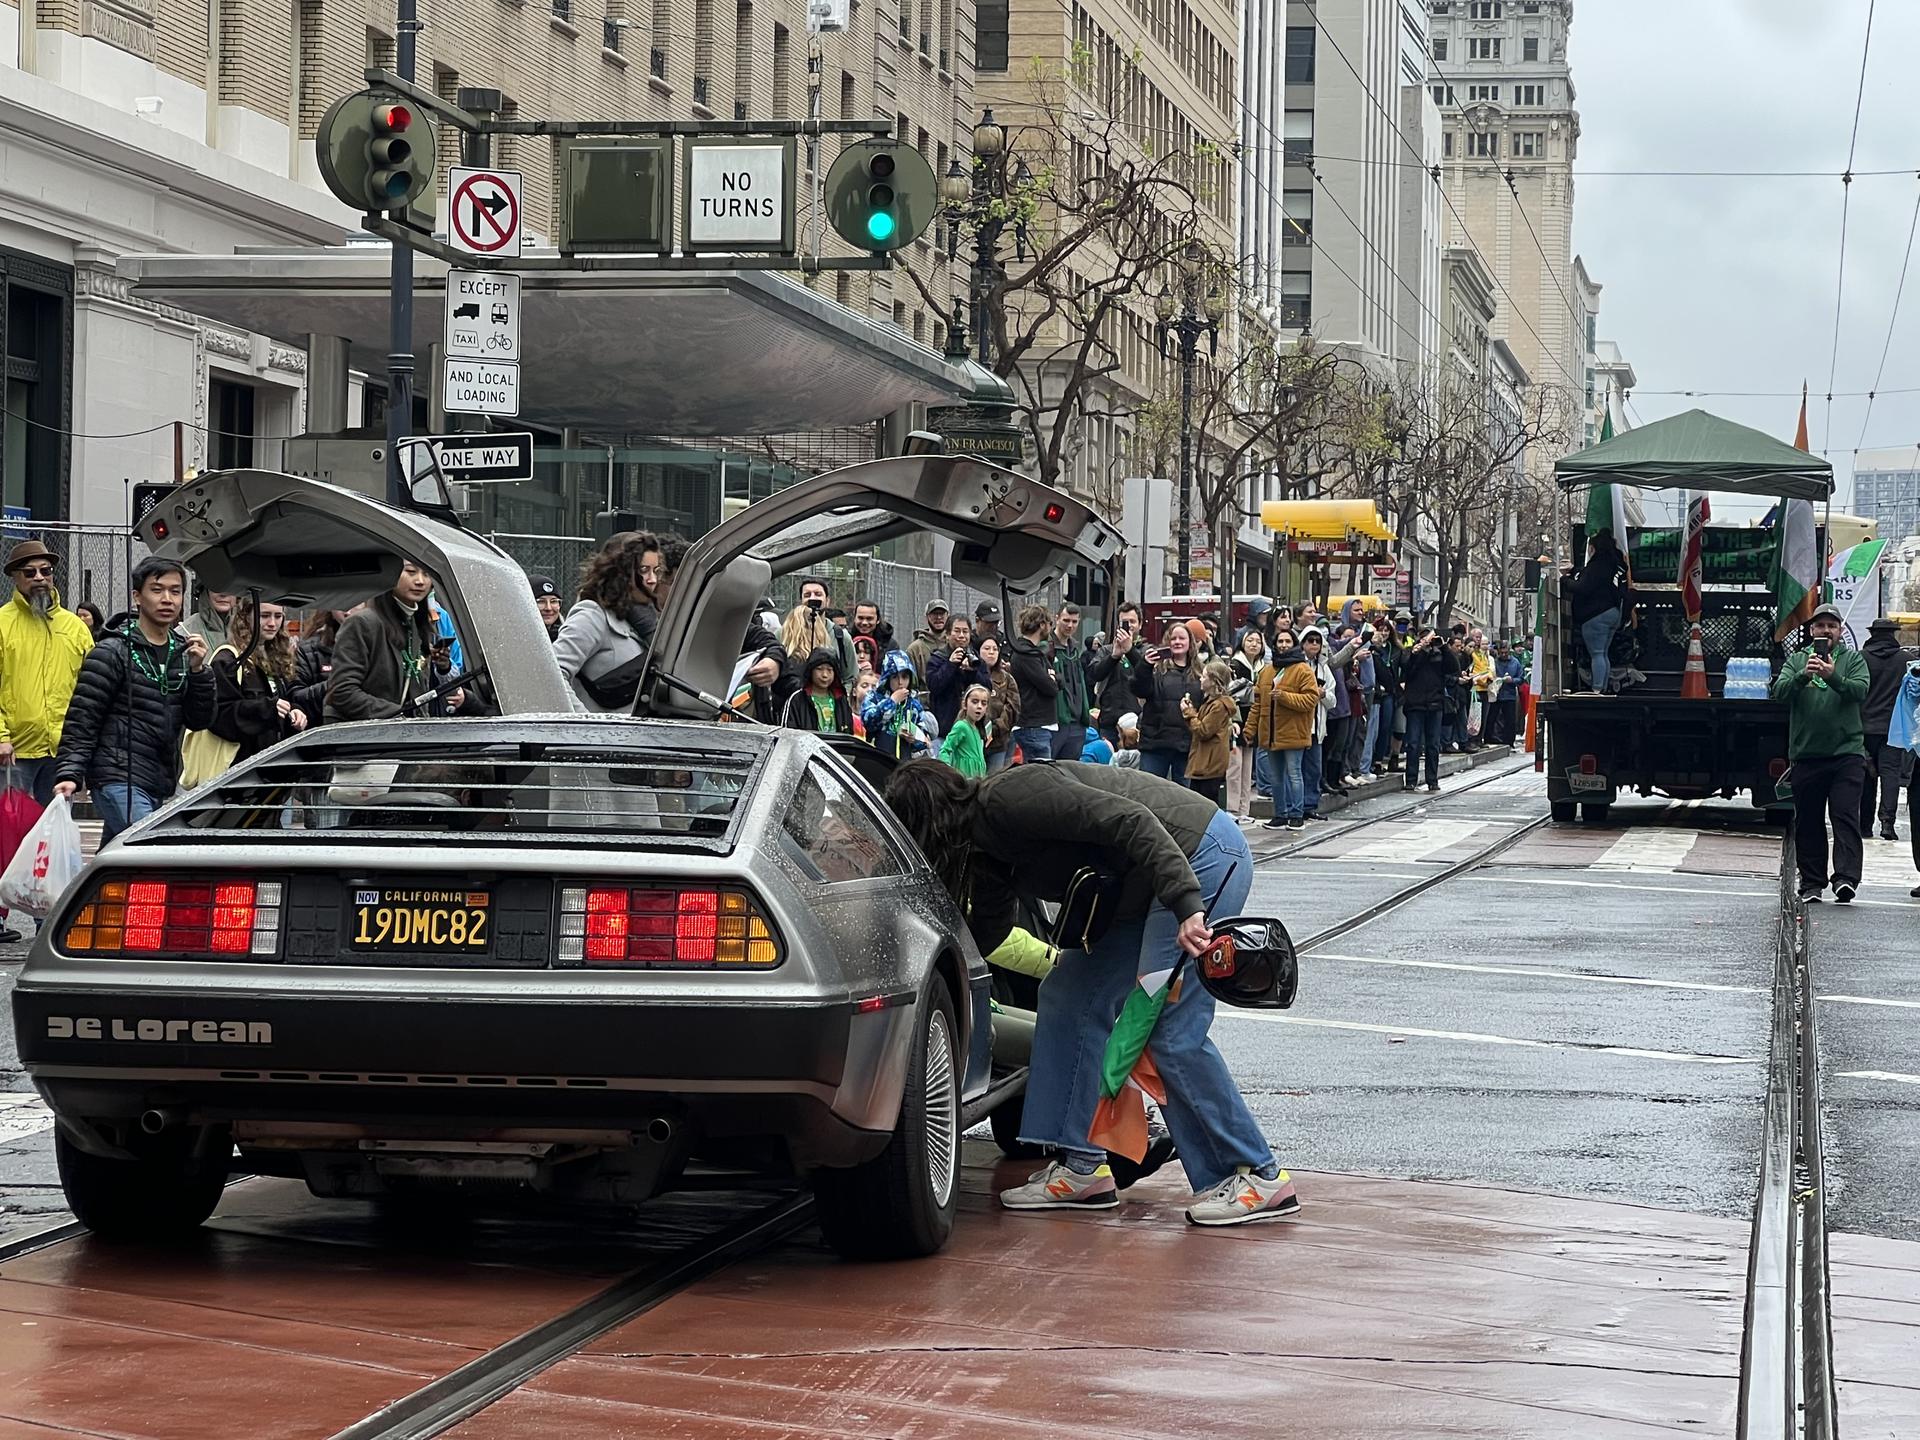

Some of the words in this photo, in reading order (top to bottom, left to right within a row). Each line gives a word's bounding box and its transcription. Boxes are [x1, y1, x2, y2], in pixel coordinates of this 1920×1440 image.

[721, 172, 751, 191] NO
[700, 197, 774, 218] TURNS
[460, 280, 508, 296] EXCEPT
[456, 334, 476, 345] TAXI
[449, 370, 473, 383] AND
[478, 372, 514, 386] LOCAL
[457, 388, 506, 403] LOADING
[944, 438, 959, 449] AN
[962, 438, 1015, 452] FRANCISCO
[440, 451, 474, 467] ONE
[482, 450, 514, 465] WAY
[1315, 541, 1338, 551] RAPID
[1716, 532, 1752, 548] THE
[1702, 551, 1737, 568] THE
[1719, 571, 1761, 580] LOCAL
[357, 892, 378, 903] NOV
[384, 890, 463, 903] CALIFORNIA
[354, 906, 487, 945] 19DMC82
